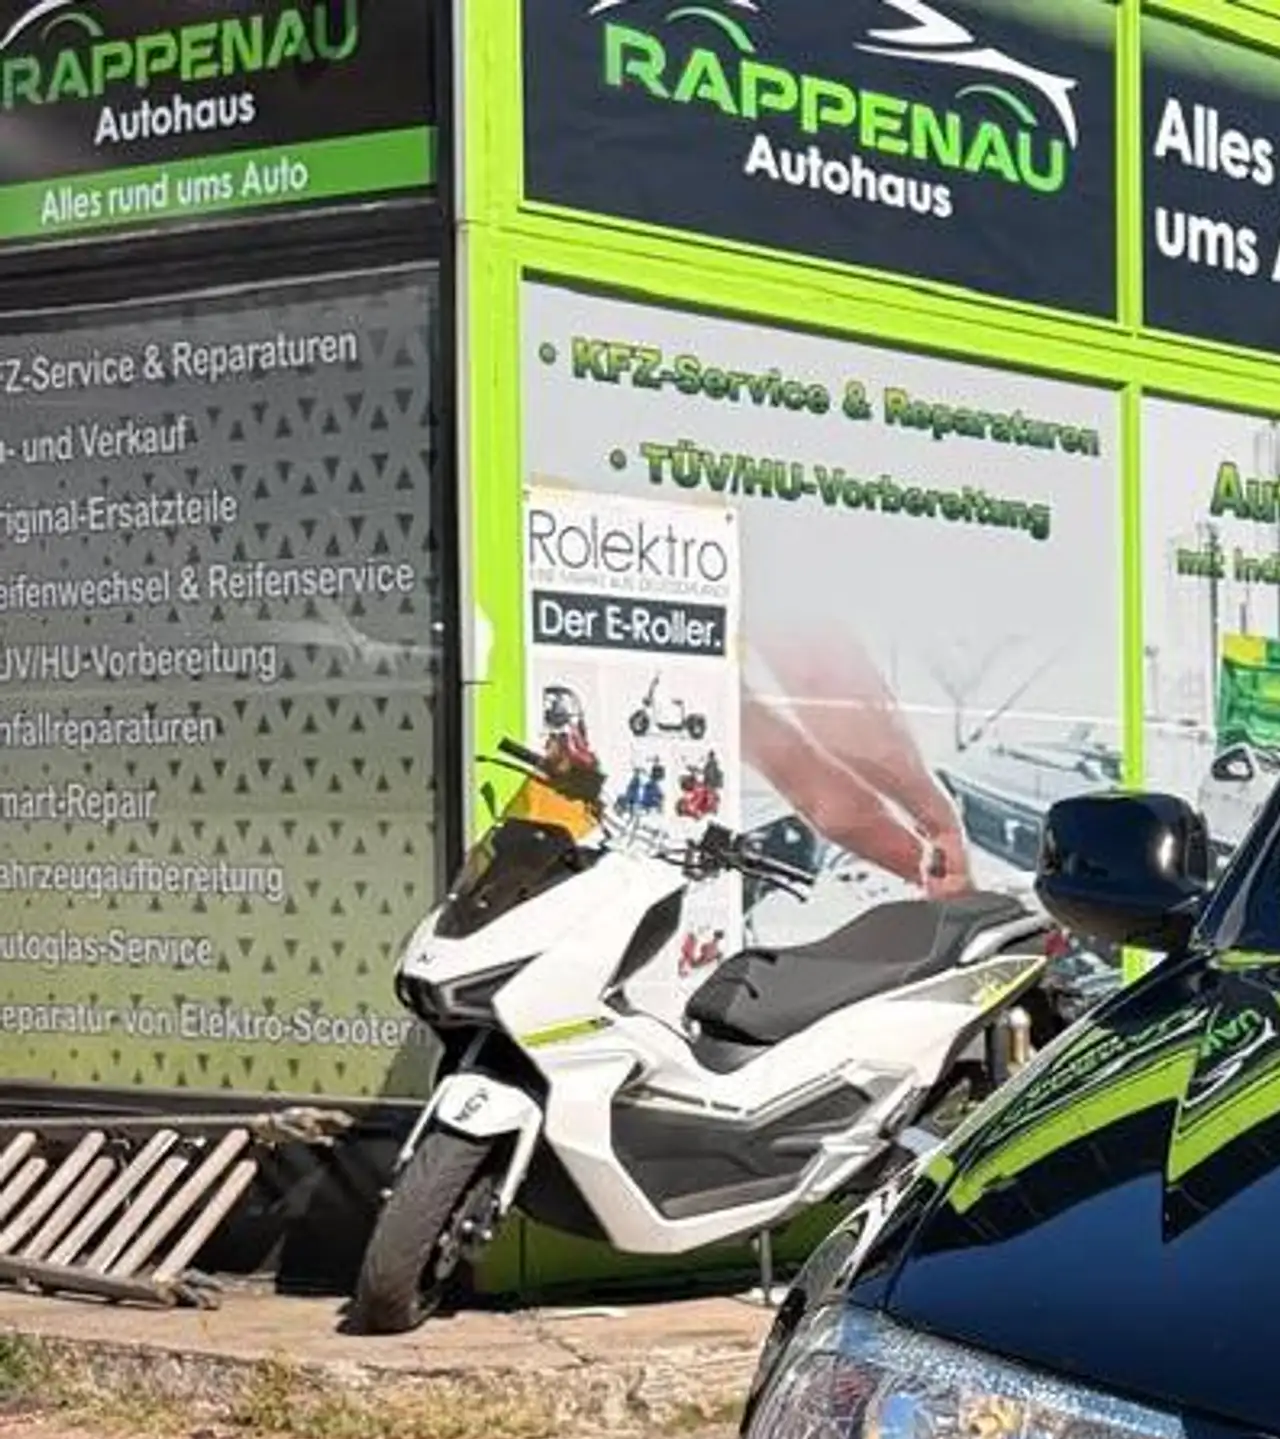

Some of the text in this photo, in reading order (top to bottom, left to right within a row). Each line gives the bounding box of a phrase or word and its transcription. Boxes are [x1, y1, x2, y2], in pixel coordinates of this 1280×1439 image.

[3, 0, 359, 109] RAPPENAU
[95, 91, 255, 144] Autohaus
[603, 22, 1065, 193] RAPPENAU
[1153, 97, 1273, 188] Alles
[41, 157, 309, 225] Alles rund ums Auto
[744, 134, 953, 219] Autohaus
[1154, 206, 1258, 277] ums
[0, 331, 357, 393] Z-Service & Reparaturen
[571, 335, 1101, 457] KFZ-Service & Reparaturen
[22, 425, 73, 464] und
[79, 414, 189, 459] Verkauf
[640, 437, 1052, 541] TÜV/HU-Vorbereitung
[179, 567, 200, 600] &
[209, 559, 415, 600] Reifenservice
[528, 509, 729, 582] Rolektro
[540, 599, 722, 649] Der E-Roller.
[123, 1009, 174, 1036] von
